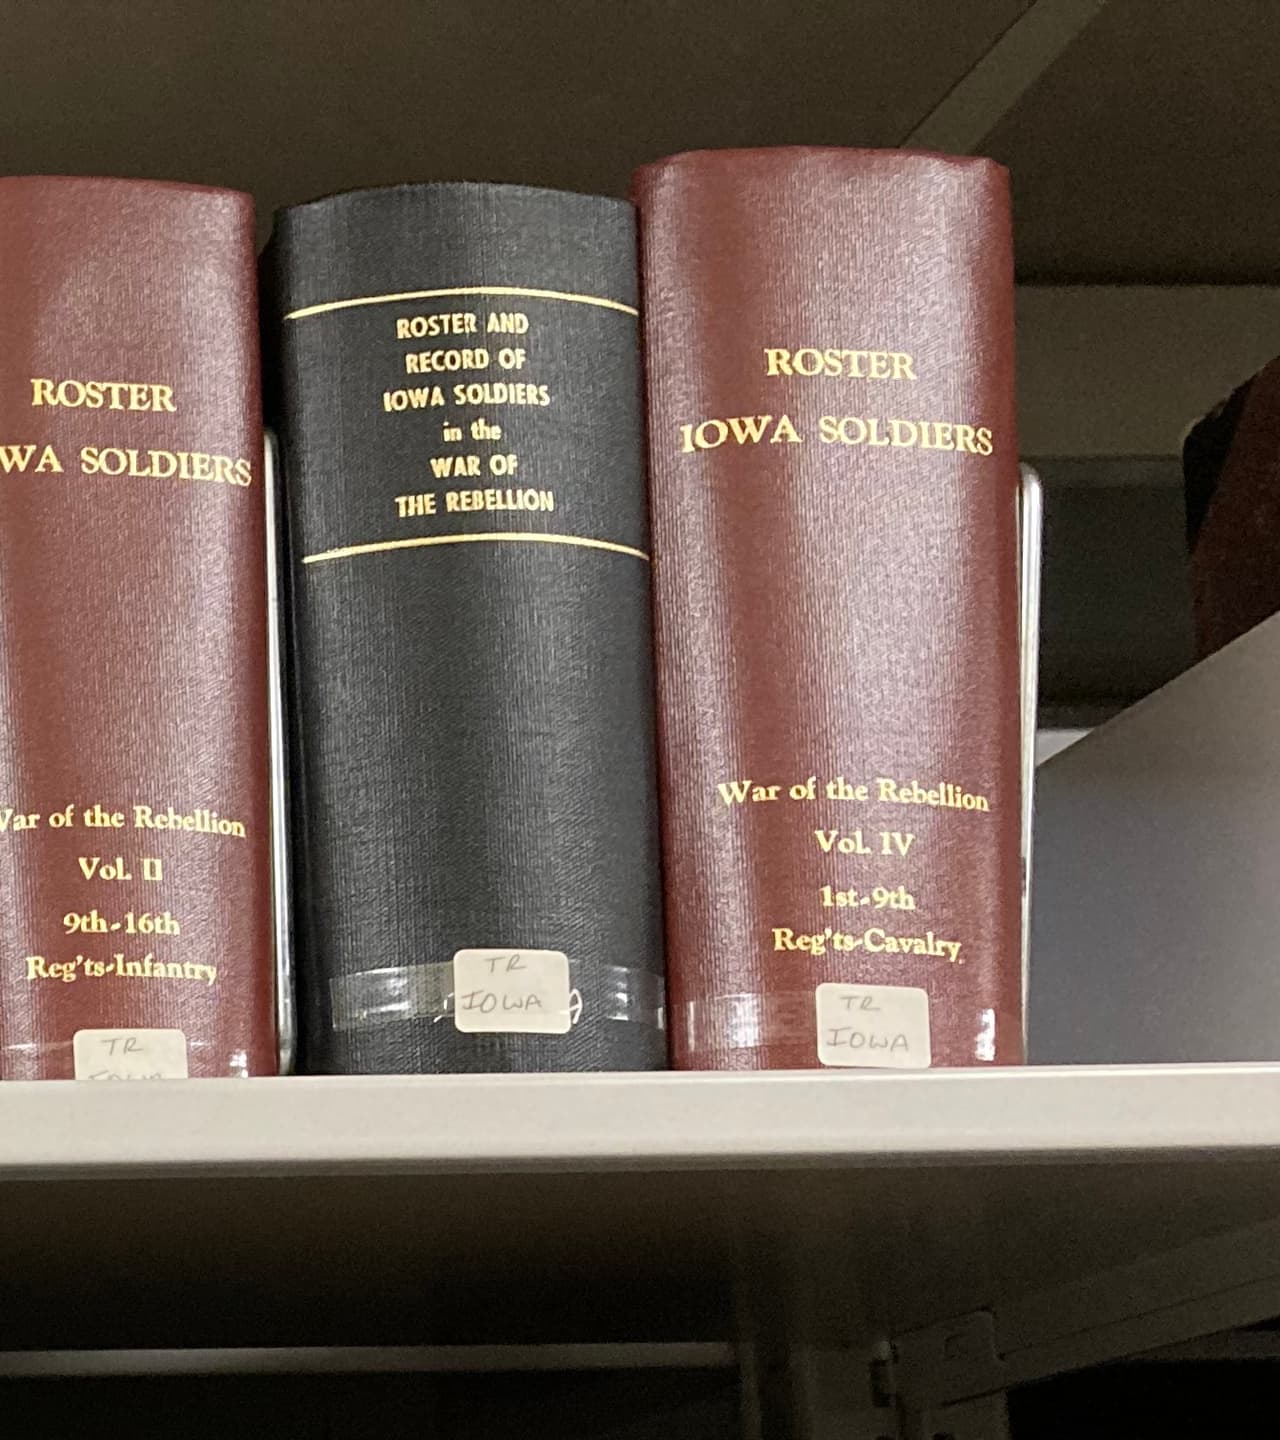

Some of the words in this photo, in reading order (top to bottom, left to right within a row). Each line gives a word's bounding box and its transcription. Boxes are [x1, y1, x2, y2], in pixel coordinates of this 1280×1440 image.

[397, 312, 476, 341] ROSTER
[487, 311, 529, 335] AND
[405, 349, 489, 375] RECORD
[498, 348, 528, 370] OF
[764, 349, 917, 380] ROSTER
[383, 386, 444, 412] IOWA
[455, 382, 550, 407] SOLDIERS
[443, 422, 465, 442] in
[471, 420, 501, 441] the
[681, 416, 802, 454] IOWA
[818, 416, 993, 456] SOLDIERS
[431, 457, 481, 479] WAR
[490, 452, 518, 476] OF
[395, 494, 436, 517] THE
[447, 488, 554, 513] REBELLION
[718, 780, 780, 806] War
[789, 777, 816, 800] of
[824, 778, 868, 802] the
[876, 778, 990, 812] Rebellion
[815, 829, 871, 855] Vol.
[881, 831, 914, 856] IV
[821, 886, 916, 911] 1st-9th
[484, 955, 525, 973] TR
[462, 990, 543, 1012] IOWA
[839, 996, 882, 1012] TR
[826, 1030, 910, 1052] IOWA
